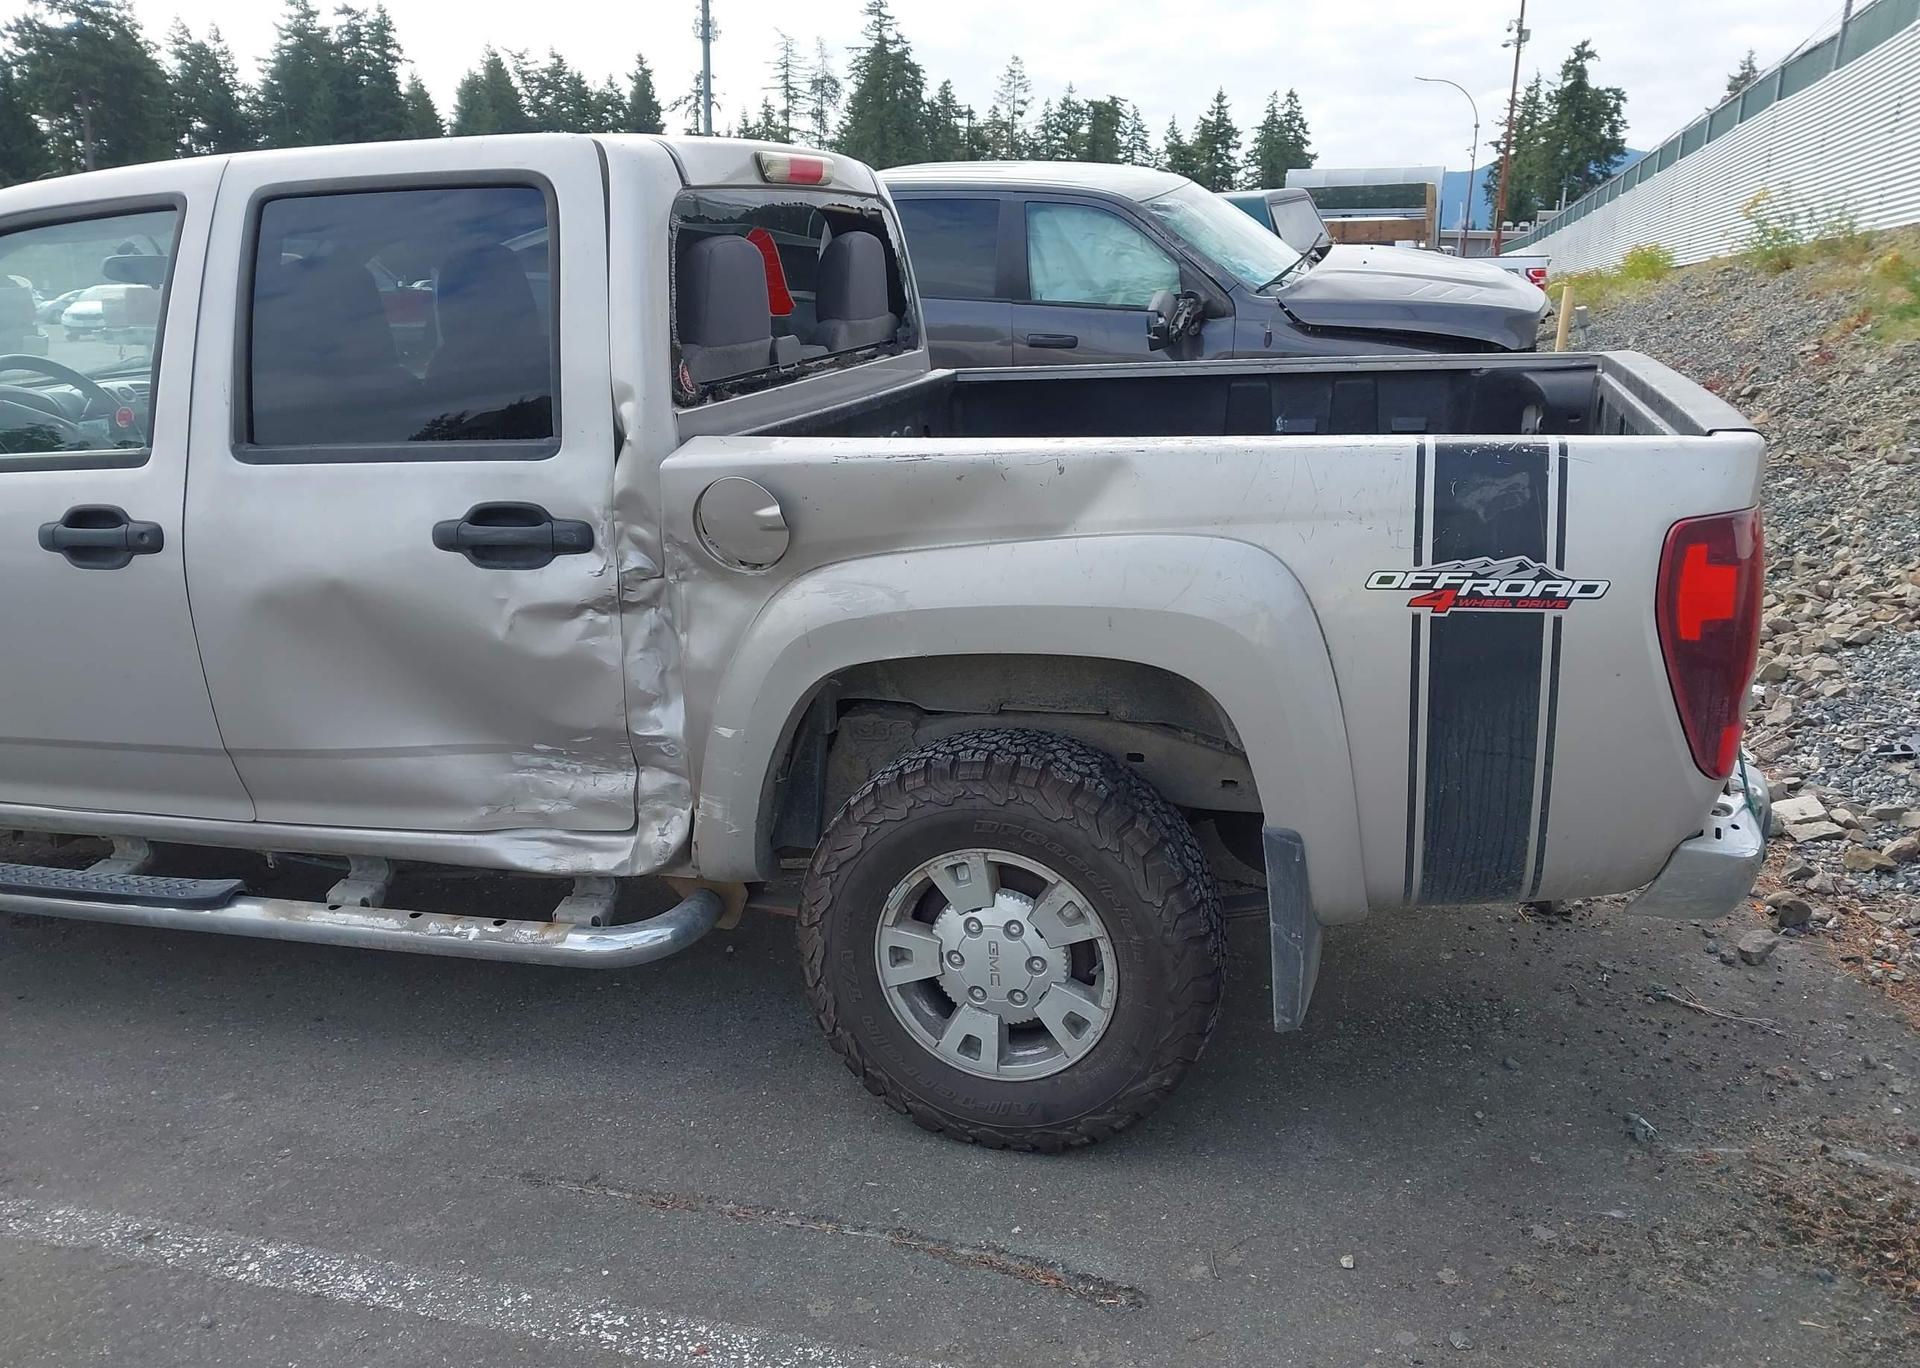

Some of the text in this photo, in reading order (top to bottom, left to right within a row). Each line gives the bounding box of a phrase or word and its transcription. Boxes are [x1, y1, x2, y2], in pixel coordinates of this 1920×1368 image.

[1408, 589, 1569, 613] 4 WHEEL DRIVE
[988, 940, 1001, 987] GMC
